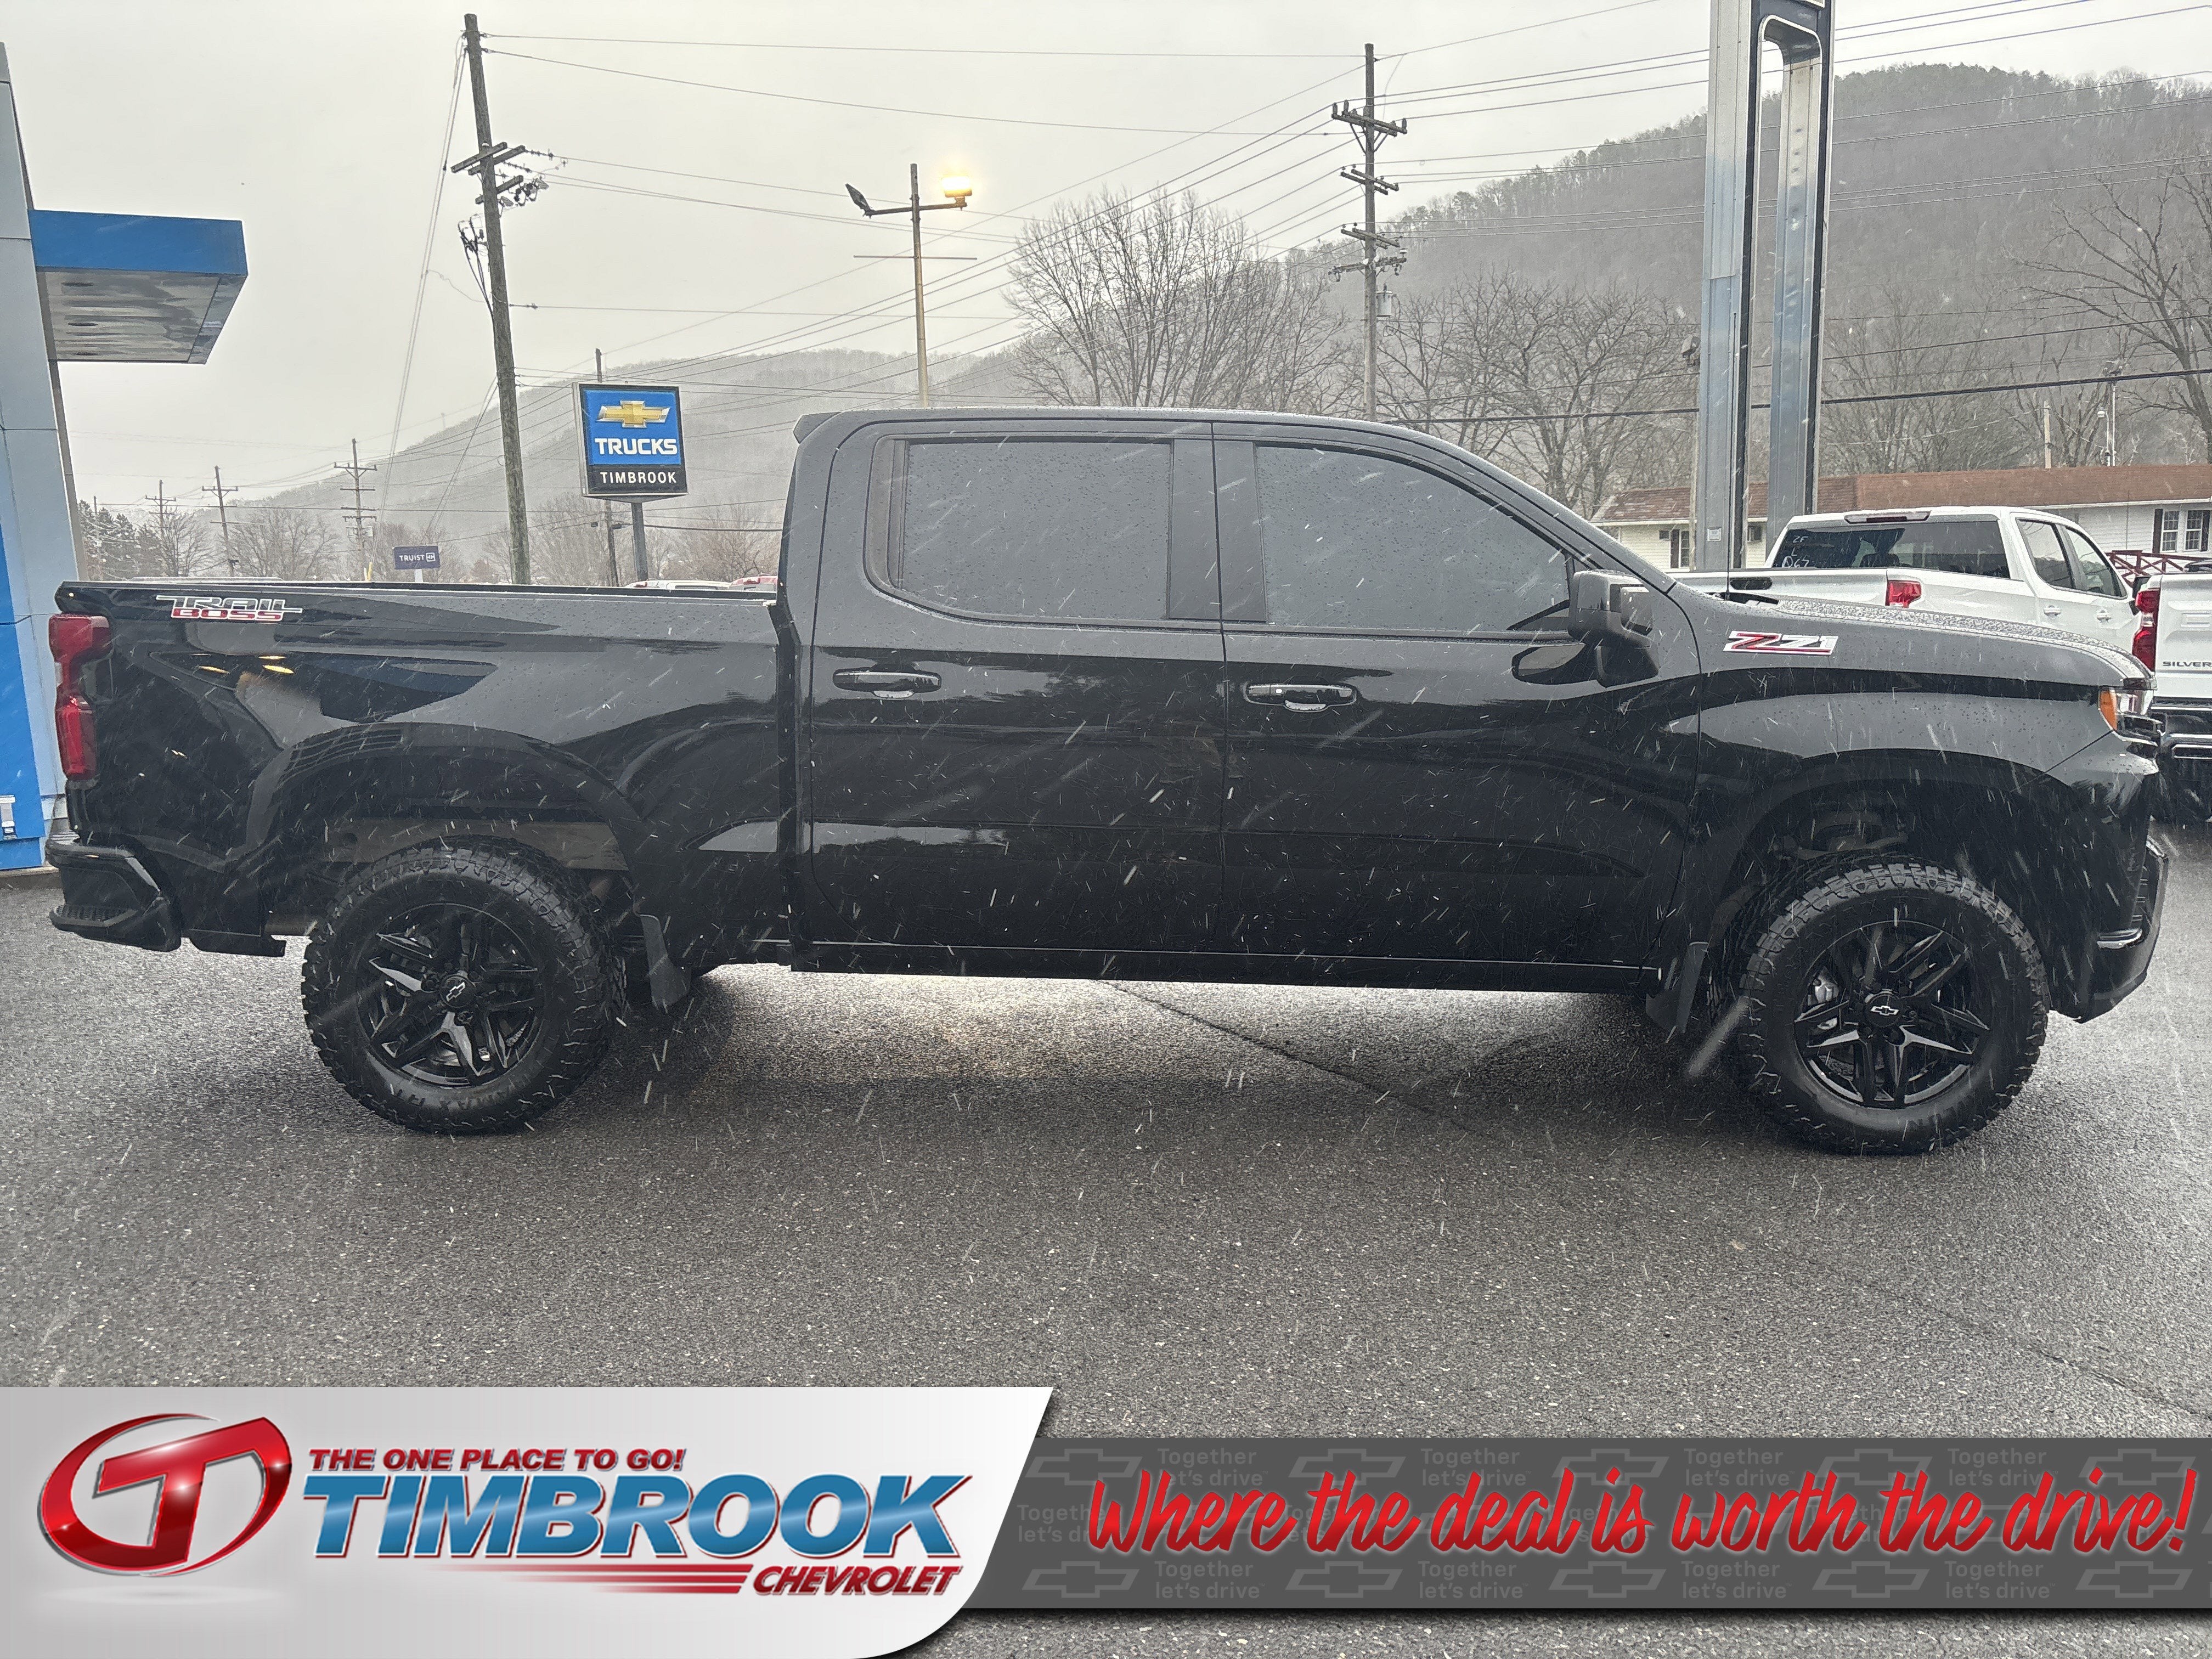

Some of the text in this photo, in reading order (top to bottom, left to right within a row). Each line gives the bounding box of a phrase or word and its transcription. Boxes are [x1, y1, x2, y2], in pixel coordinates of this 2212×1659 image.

[595, 438, 678, 455] TRUCKS
[600, 471, 677, 483] TIMBROOK
[156, 595, 303, 613] TRAIL
[171, 607, 284, 622] BOSS
[1723, 630, 1838, 656] Z71
